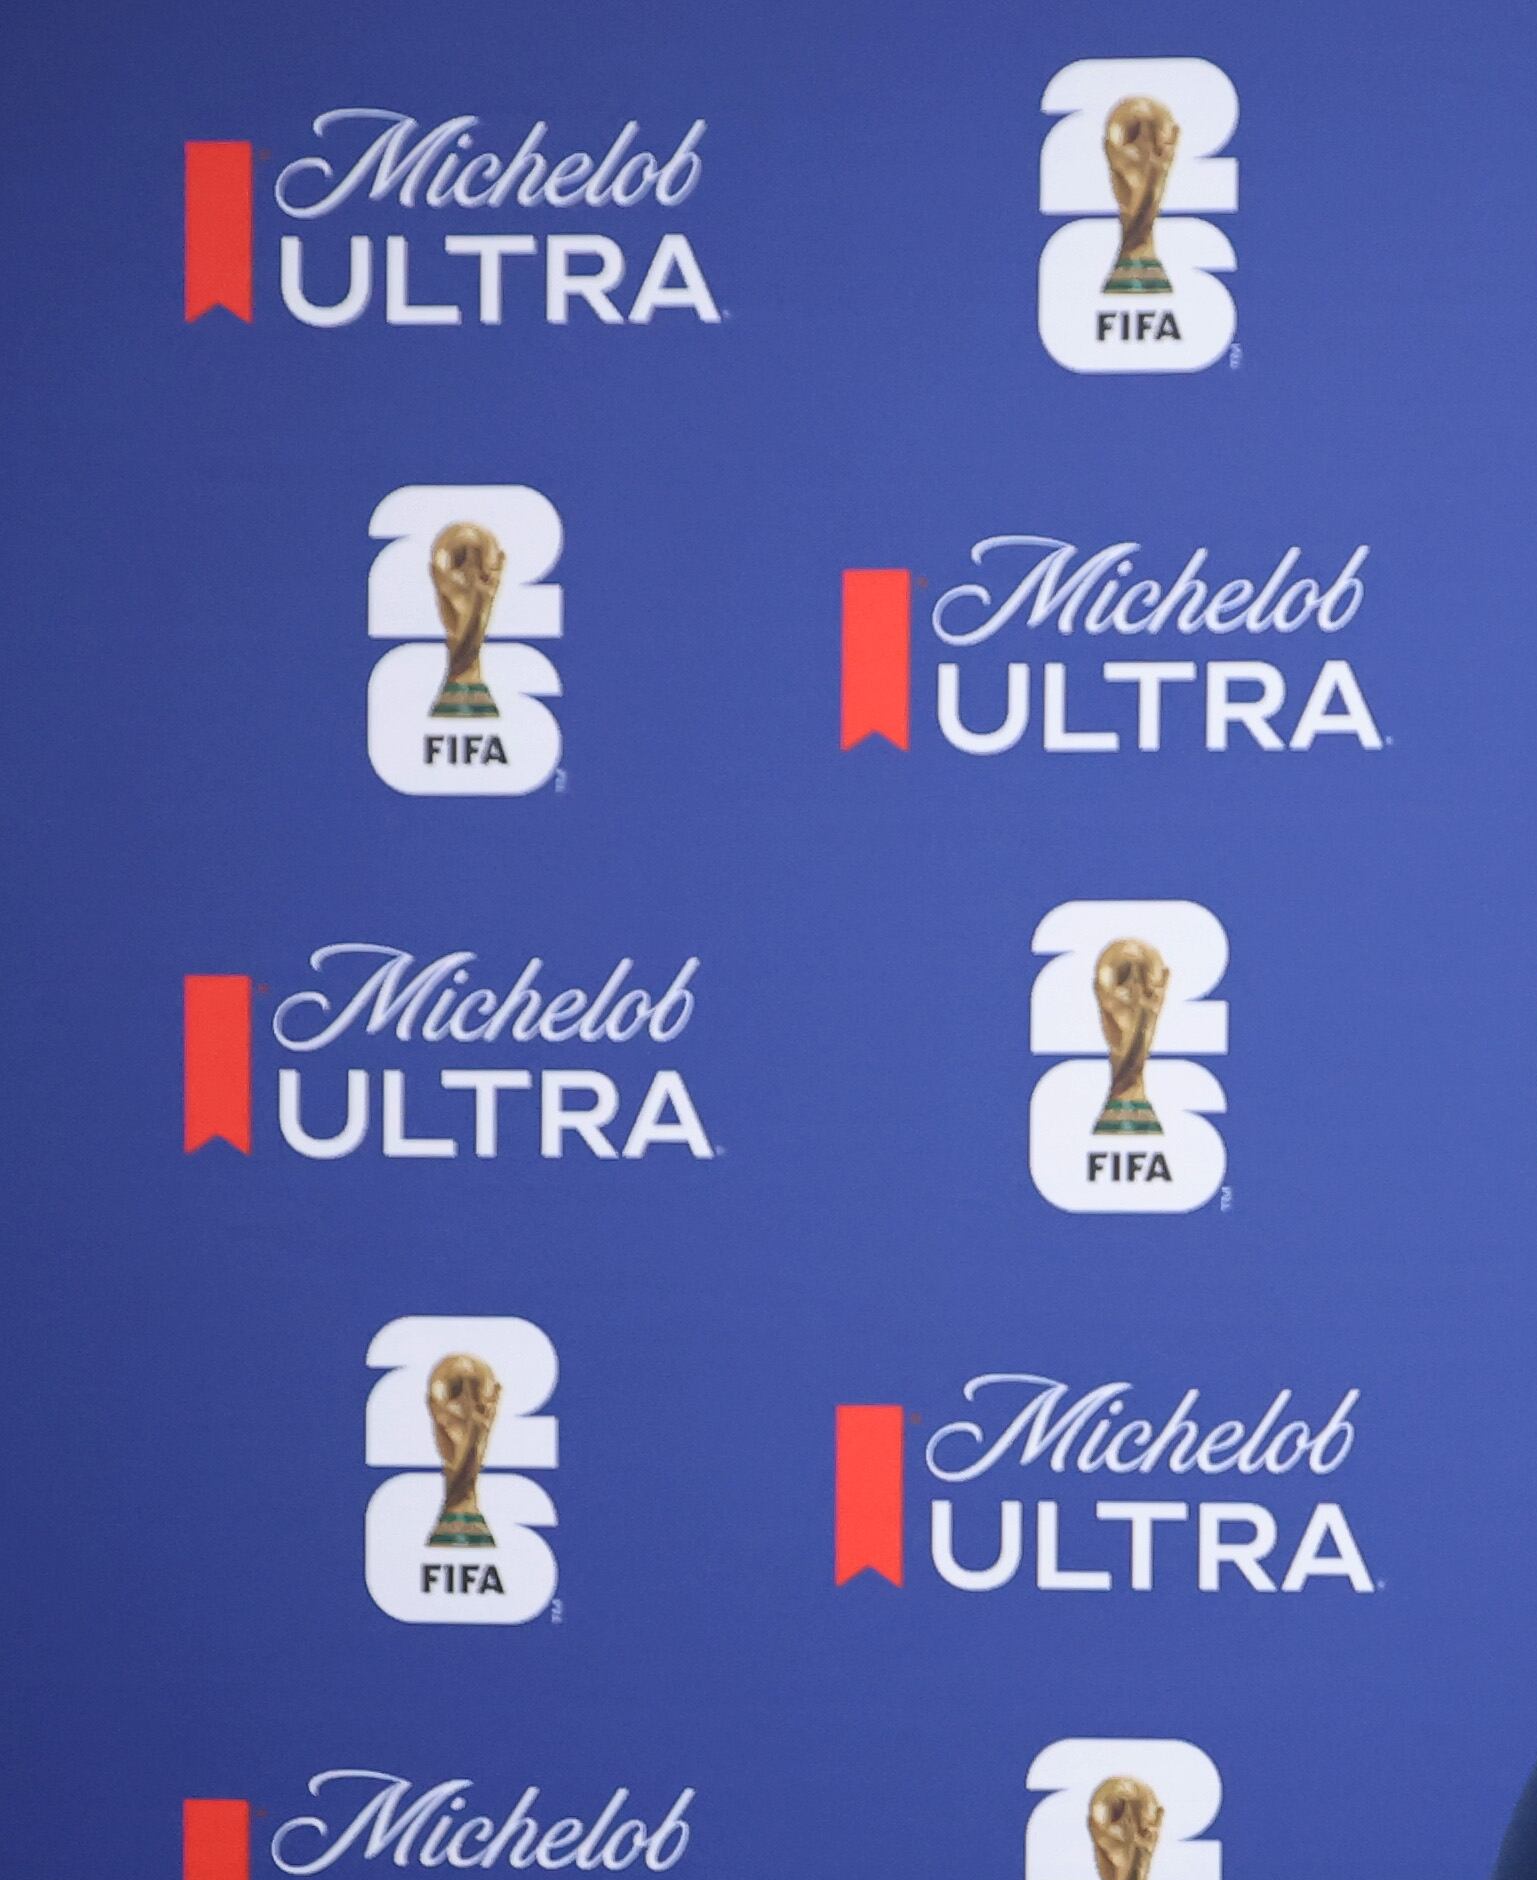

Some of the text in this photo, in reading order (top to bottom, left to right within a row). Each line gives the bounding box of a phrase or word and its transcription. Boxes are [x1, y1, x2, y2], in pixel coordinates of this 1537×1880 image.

[275, 109, 706, 218] Michelob
[281, 234, 721, 327] ULTRA
[1097, 312, 1181, 341] FIFA
[933, 536, 1369, 645] Michelob
[425, 735, 508, 765] FIFA
[938, 660, 1383, 755] ULTRA
[273, 943, 700, 1051] Michelob
[279, 1069, 714, 1159] ULTRA
[1088, 1152, 1172, 1182] FIFA
[926, 1374, 1359, 1481] Michelob
[422, 1564, 504, 1595] FIFA
[932, 1500, 1374, 1593] ULTRA
[272, 1770, 695, 1874] Michelob
